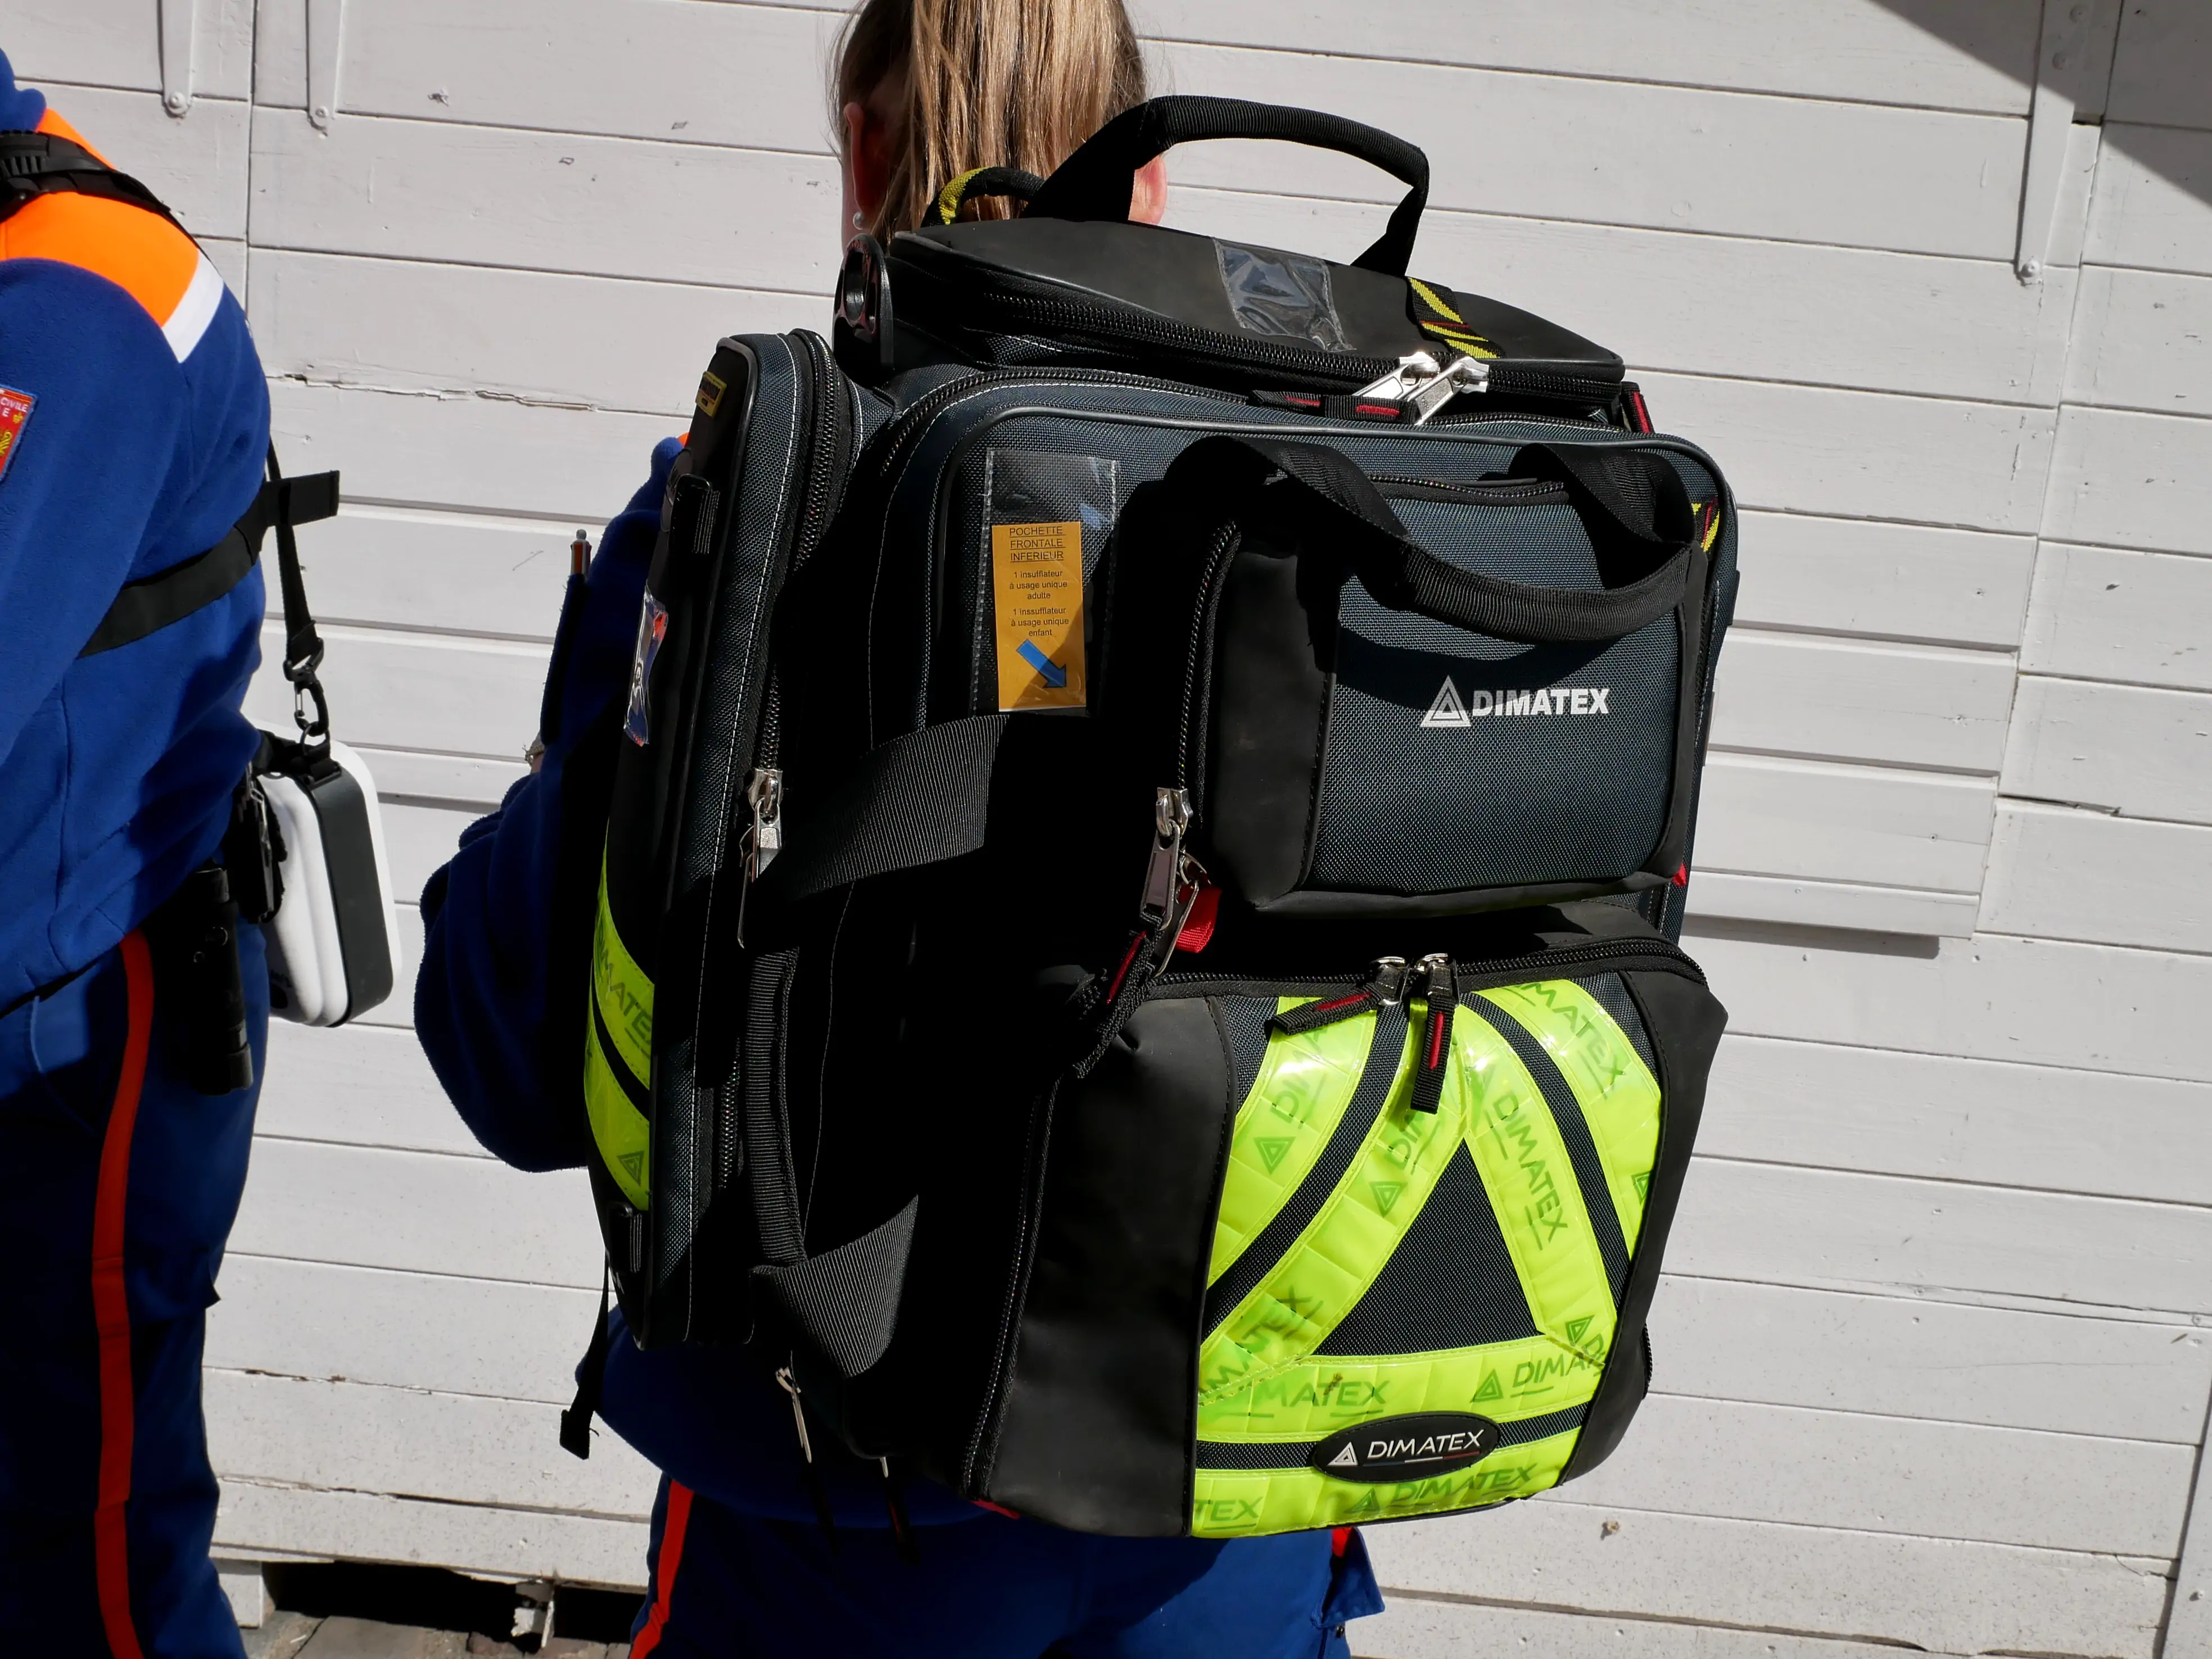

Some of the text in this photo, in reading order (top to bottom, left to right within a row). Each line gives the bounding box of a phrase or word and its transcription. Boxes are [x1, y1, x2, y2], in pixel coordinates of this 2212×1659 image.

[1, 397, 28, 413] CIVILE
[1010, 526, 1063, 536] POCHETTE
[1010, 538, 1063, 549] FRONTALE
[1011, 551, 1064, 561] INFERIEUR
[1043, 618, 1069, 626] unique
[1472, 688, 1609, 717] DIMATEX
[1516, 982, 1626, 1091] MATEX
[1492, 1090, 1568, 1244] DIMATEX
[1512, 1353, 1591, 1388] DIMA
[1367, 1429, 1484, 1459] DIMATEX
[1391, 1463, 1537, 1502] DIMATEX
